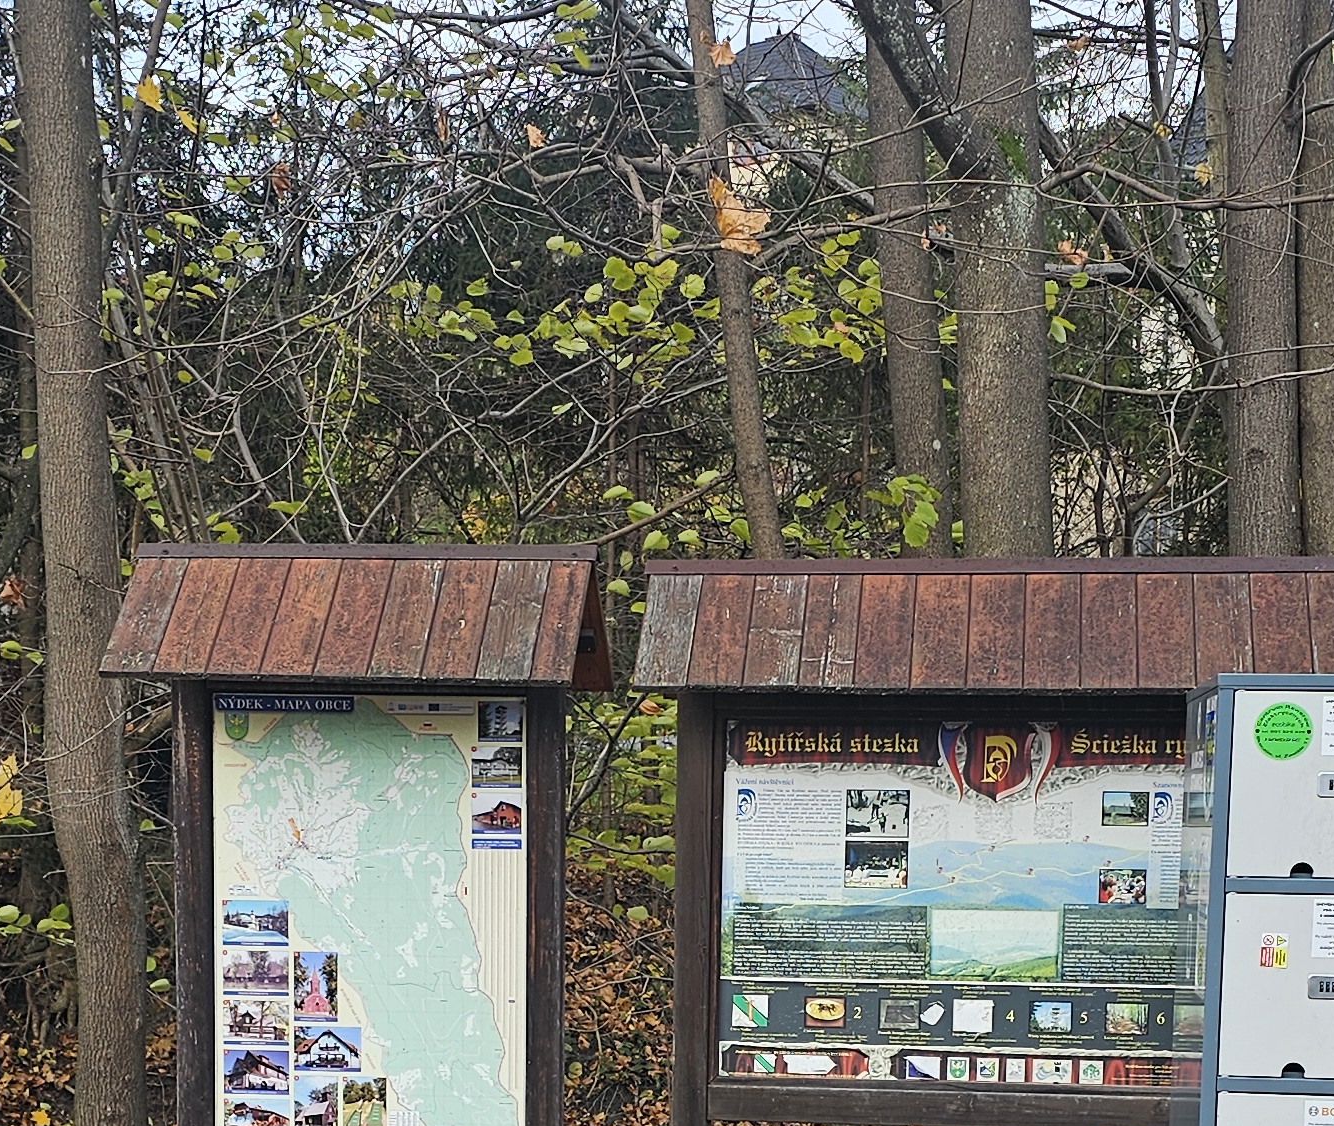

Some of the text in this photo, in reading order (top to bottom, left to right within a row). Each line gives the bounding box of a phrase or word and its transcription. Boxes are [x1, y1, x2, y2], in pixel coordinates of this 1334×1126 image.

[218, 695, 264, 709] NÝDEK
[274, 699, 312, 710] MAPA
[314, 699, 352, 711] OBCE
[745, 731, 919, 758] Rytířská stezka
[1070, 728, 1186, 760] Ścieżka ry
[853, 1006, 862, 1020] 2
[1005, 1009, 1016, 1023] 4
[1079, 1011, 1089, 1024] 5
[1156, 1012, 1166, 1025] 6
